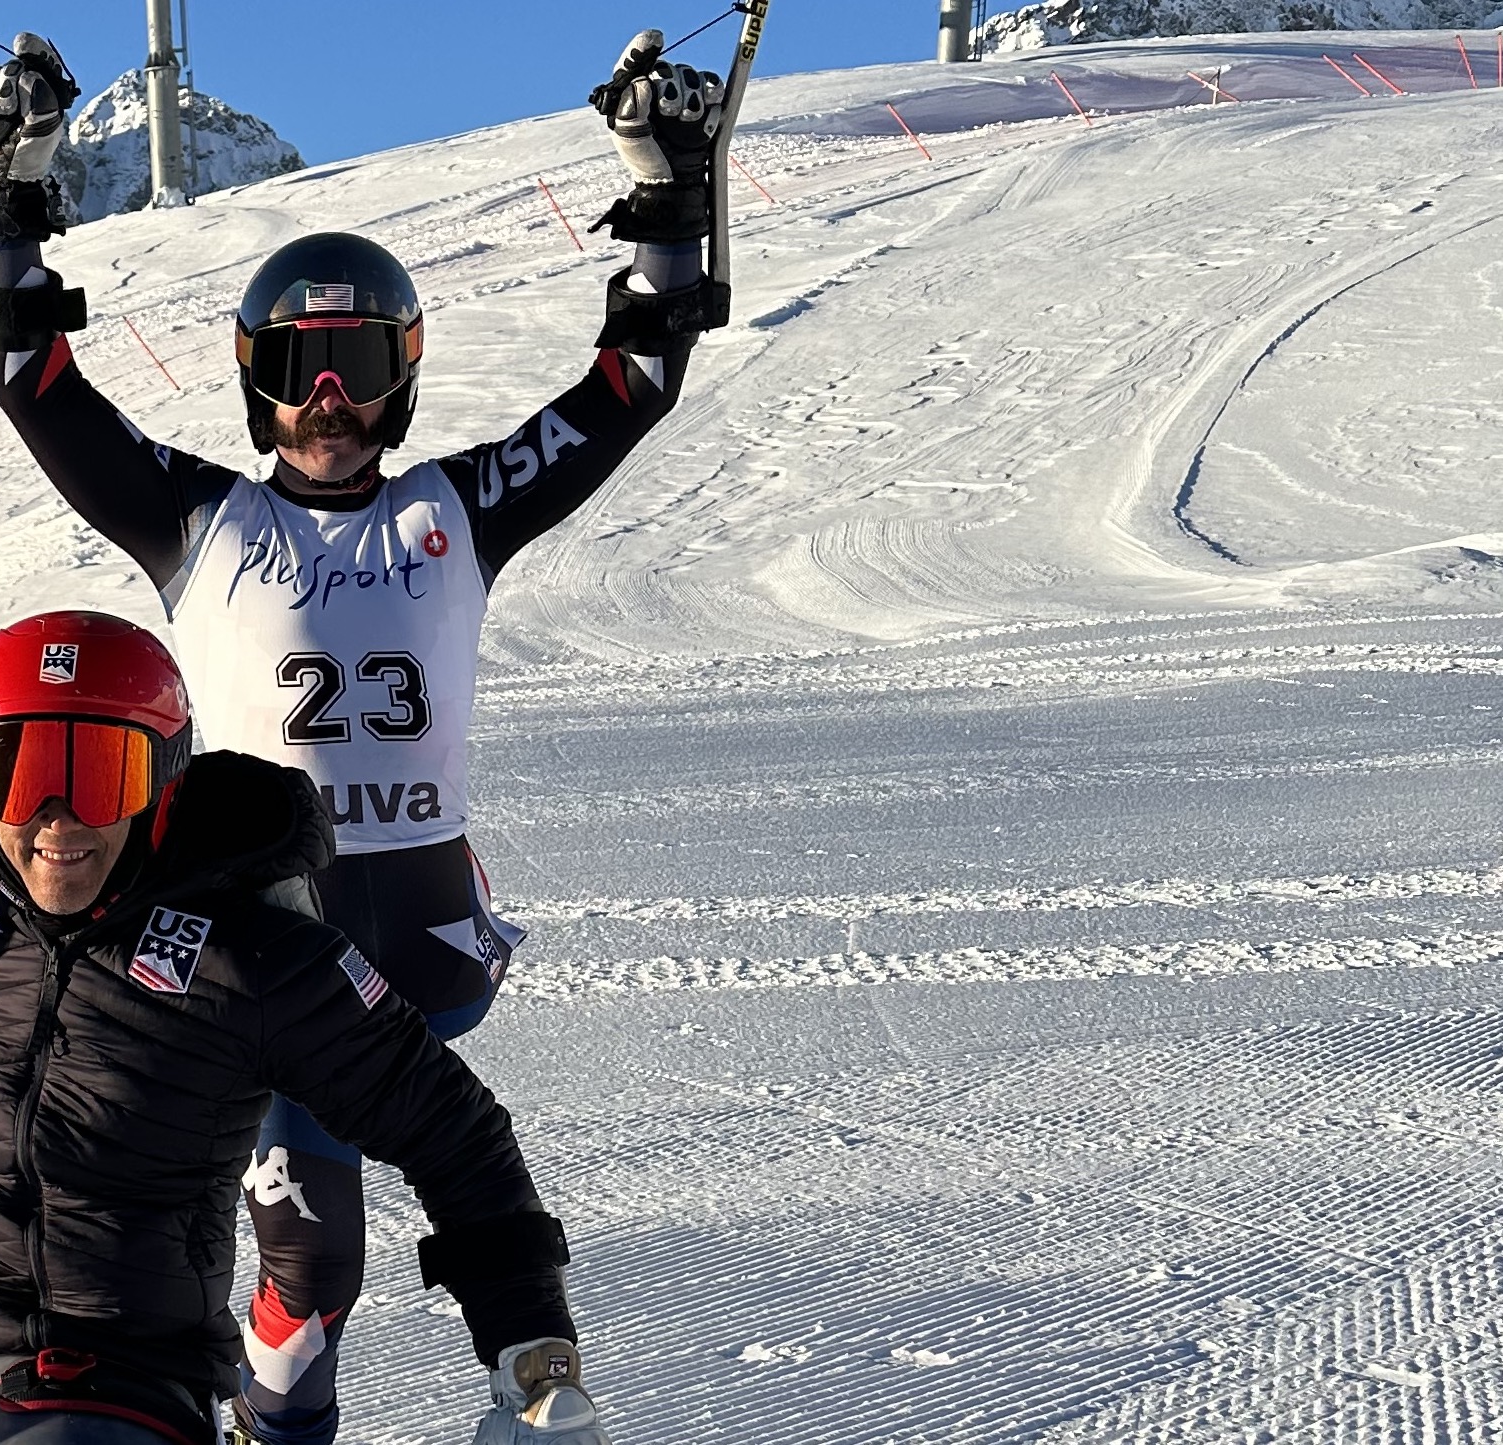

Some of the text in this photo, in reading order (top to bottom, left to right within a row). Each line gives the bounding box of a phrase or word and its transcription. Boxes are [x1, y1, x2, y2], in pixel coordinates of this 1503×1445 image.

[478, 407, 588, 508] USA
[45, 645, 77, 657] US
[276, 651, 433, 745] 23
[150, 907, 207, 946] US
[475, 932, 492, 959] US
